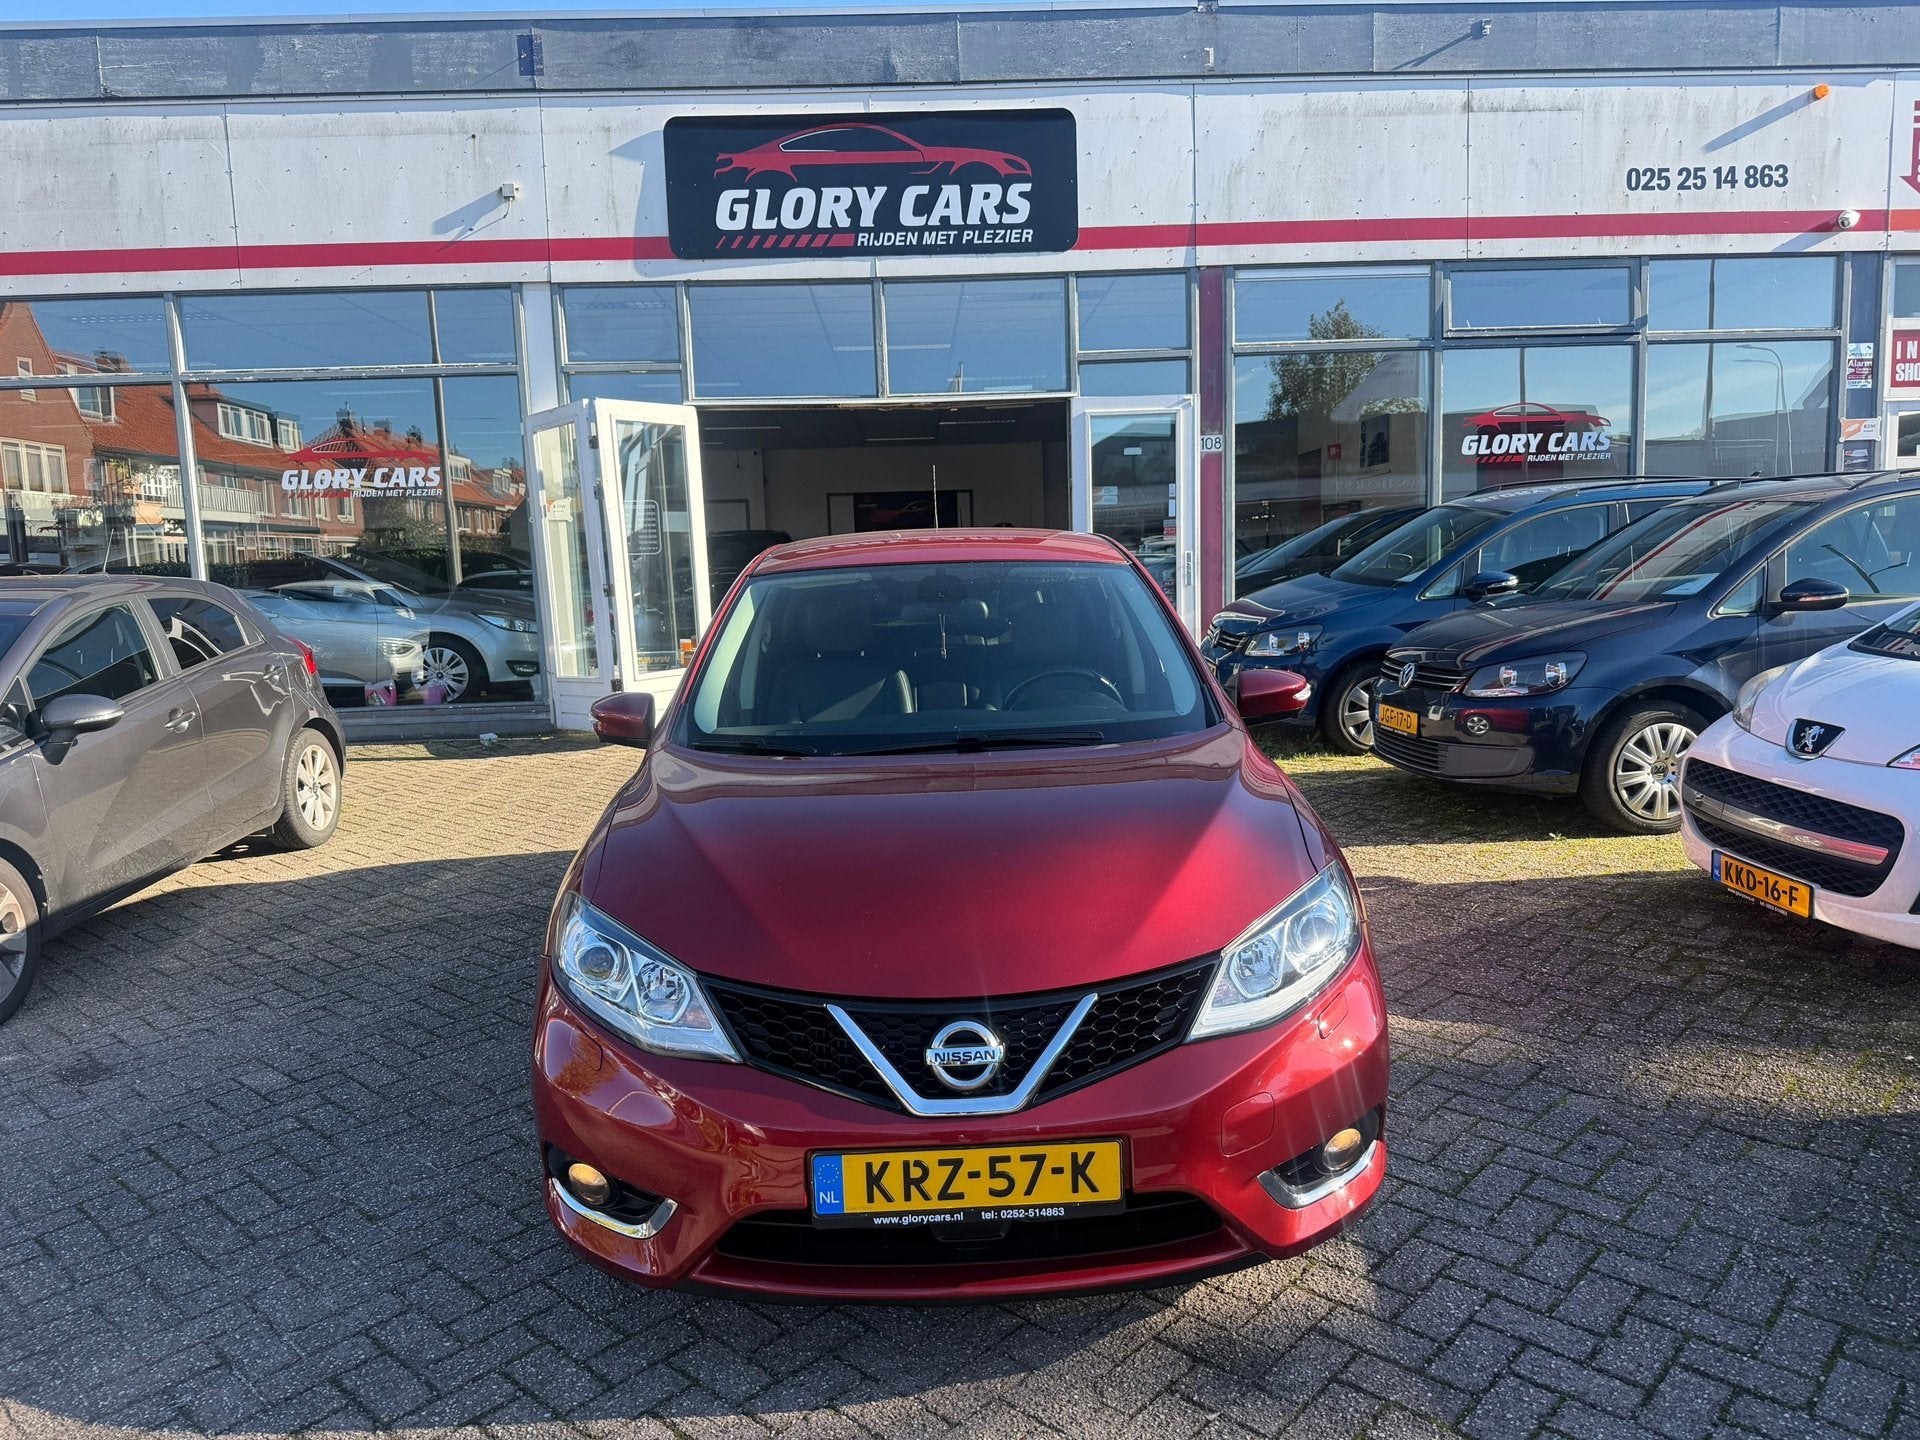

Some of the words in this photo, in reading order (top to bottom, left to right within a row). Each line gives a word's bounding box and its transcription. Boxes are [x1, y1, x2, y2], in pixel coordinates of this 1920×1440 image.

[1626, 167, 1671, 191] 025
[1677, 166, 1707, 190] 25
[1712, 165, 1738, 189] 14
[1744, 164, 1789, 188] 863
[715, 186, 888, 231] GLORY
[899, 183, 1033, 227] CARS
[857, 231, 919, 247] RIJDEN
[922, 230, 959, 245] MET
[962, 228, 1034, 244] PLEZIER
[1847, 359, 1873, 367] Alarm
[1201, 436, 1221, 450] 108
[1461, 433, 1544, 456] GLORY
[1547, 431, 1612, 452] CARS
[1527, 454, 1557, 462] RIJDEN
[1558, 453, 1575, 461] MET
[1577, 452, 1612, 461] PLEZIER
[281, 468, 367, 491] GLORY
[373, 467, 441, 488] CARS
[353, 489, 385, 498] RIJDEN
[386, 489, 403, 497] MET
[406, 488, 442, 497] PLEZIER
[1381, 706, 1412, 730] JGF-17-D
[1724, 860, 1799, 907] KKD-16-F
[934, 1049, 996, 1063] NISSAN
[865, 1151, 1100, 1204] KRZ-57-K
[819, 1190, 840, 1204] NL
[873, 1212, 964, 1226] www.glorycars.nl
[981, 1210, 998, 1220] tel:
[1000, 1207, 1065, 1219] 0252-514863
